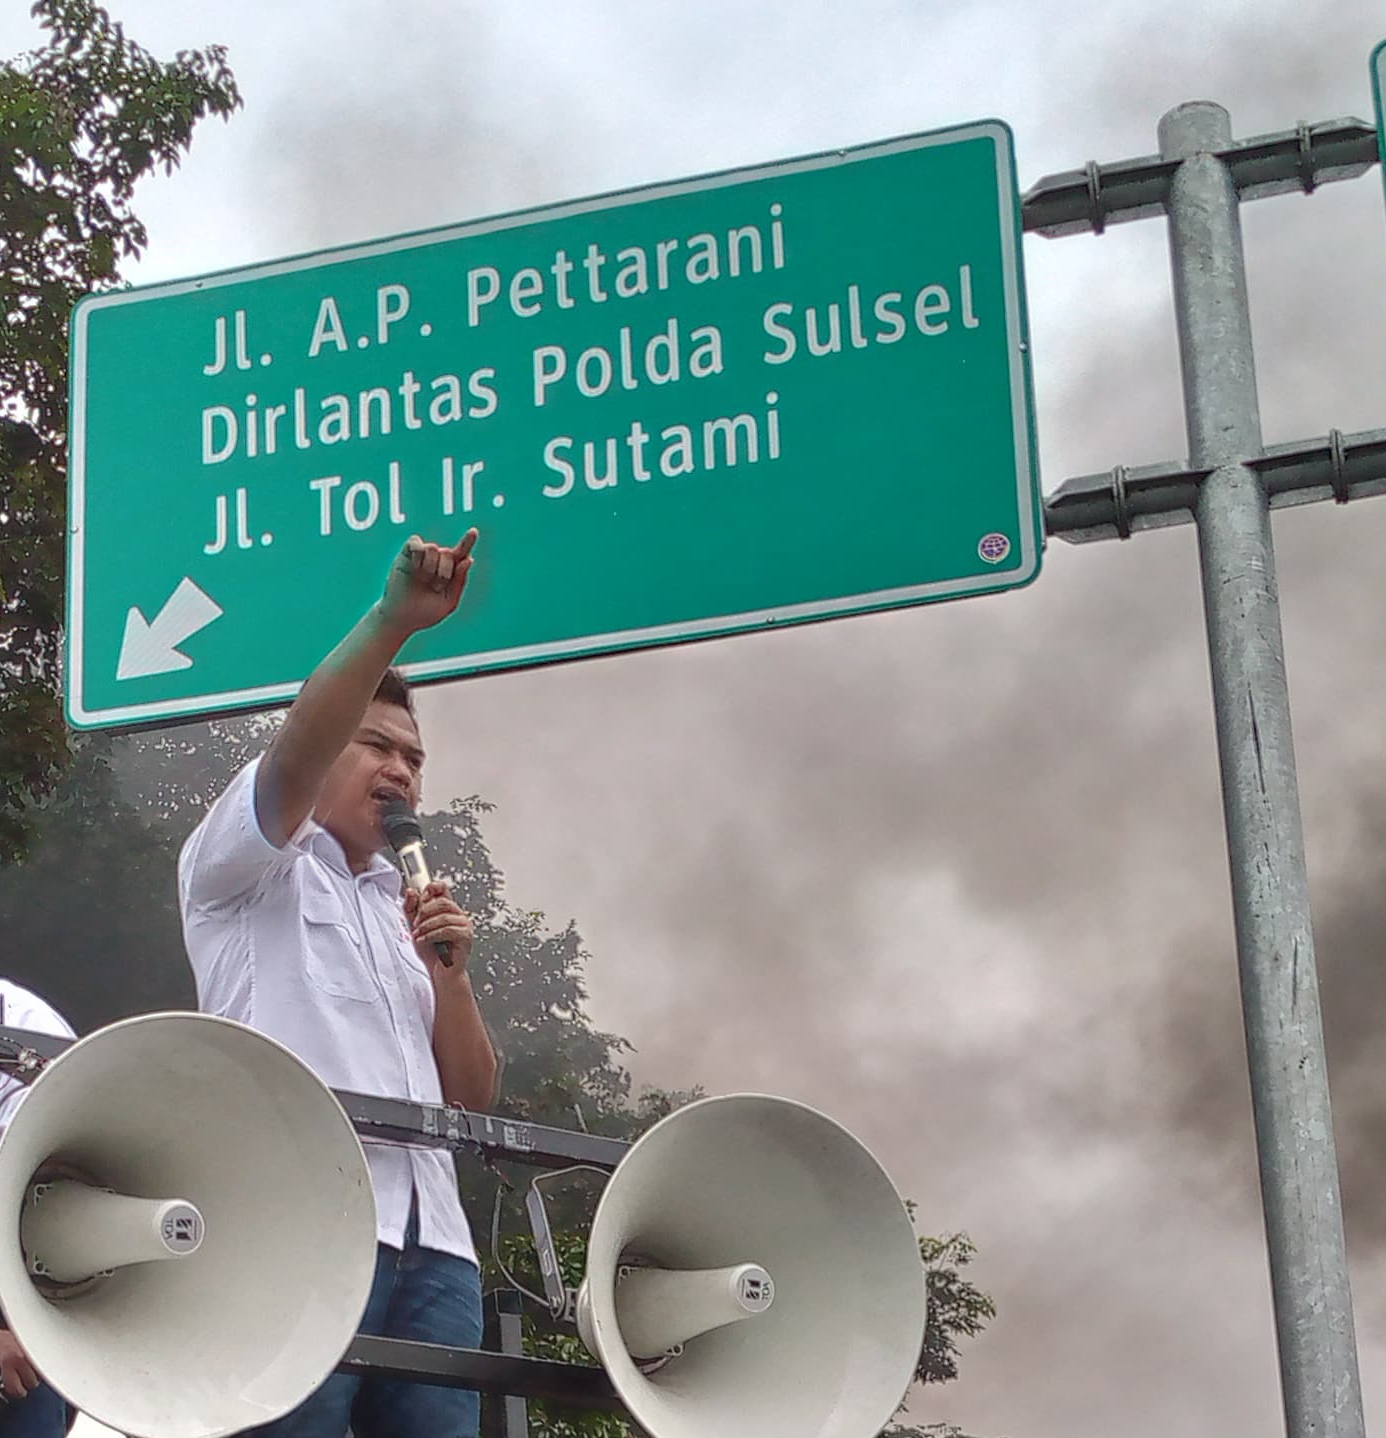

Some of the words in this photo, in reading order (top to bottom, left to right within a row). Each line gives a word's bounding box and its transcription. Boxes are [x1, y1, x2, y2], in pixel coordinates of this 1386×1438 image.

[203, 310, 272, 376] Jl.
[309, 285, 432, 356] A.P.
[469, 204, 784, 327] Pettarani
[203, 366, 498, 465] Dirlantas
[534, 319, 724, 405] Polda
[763, 266, 979, 364] Sulsel
[204, 488, 273, 555] Jl.
[310, 462, 406, 535] Tol
[443, 458, 505, 515] Ir.
[543, 392, 780, 498] Sutami
